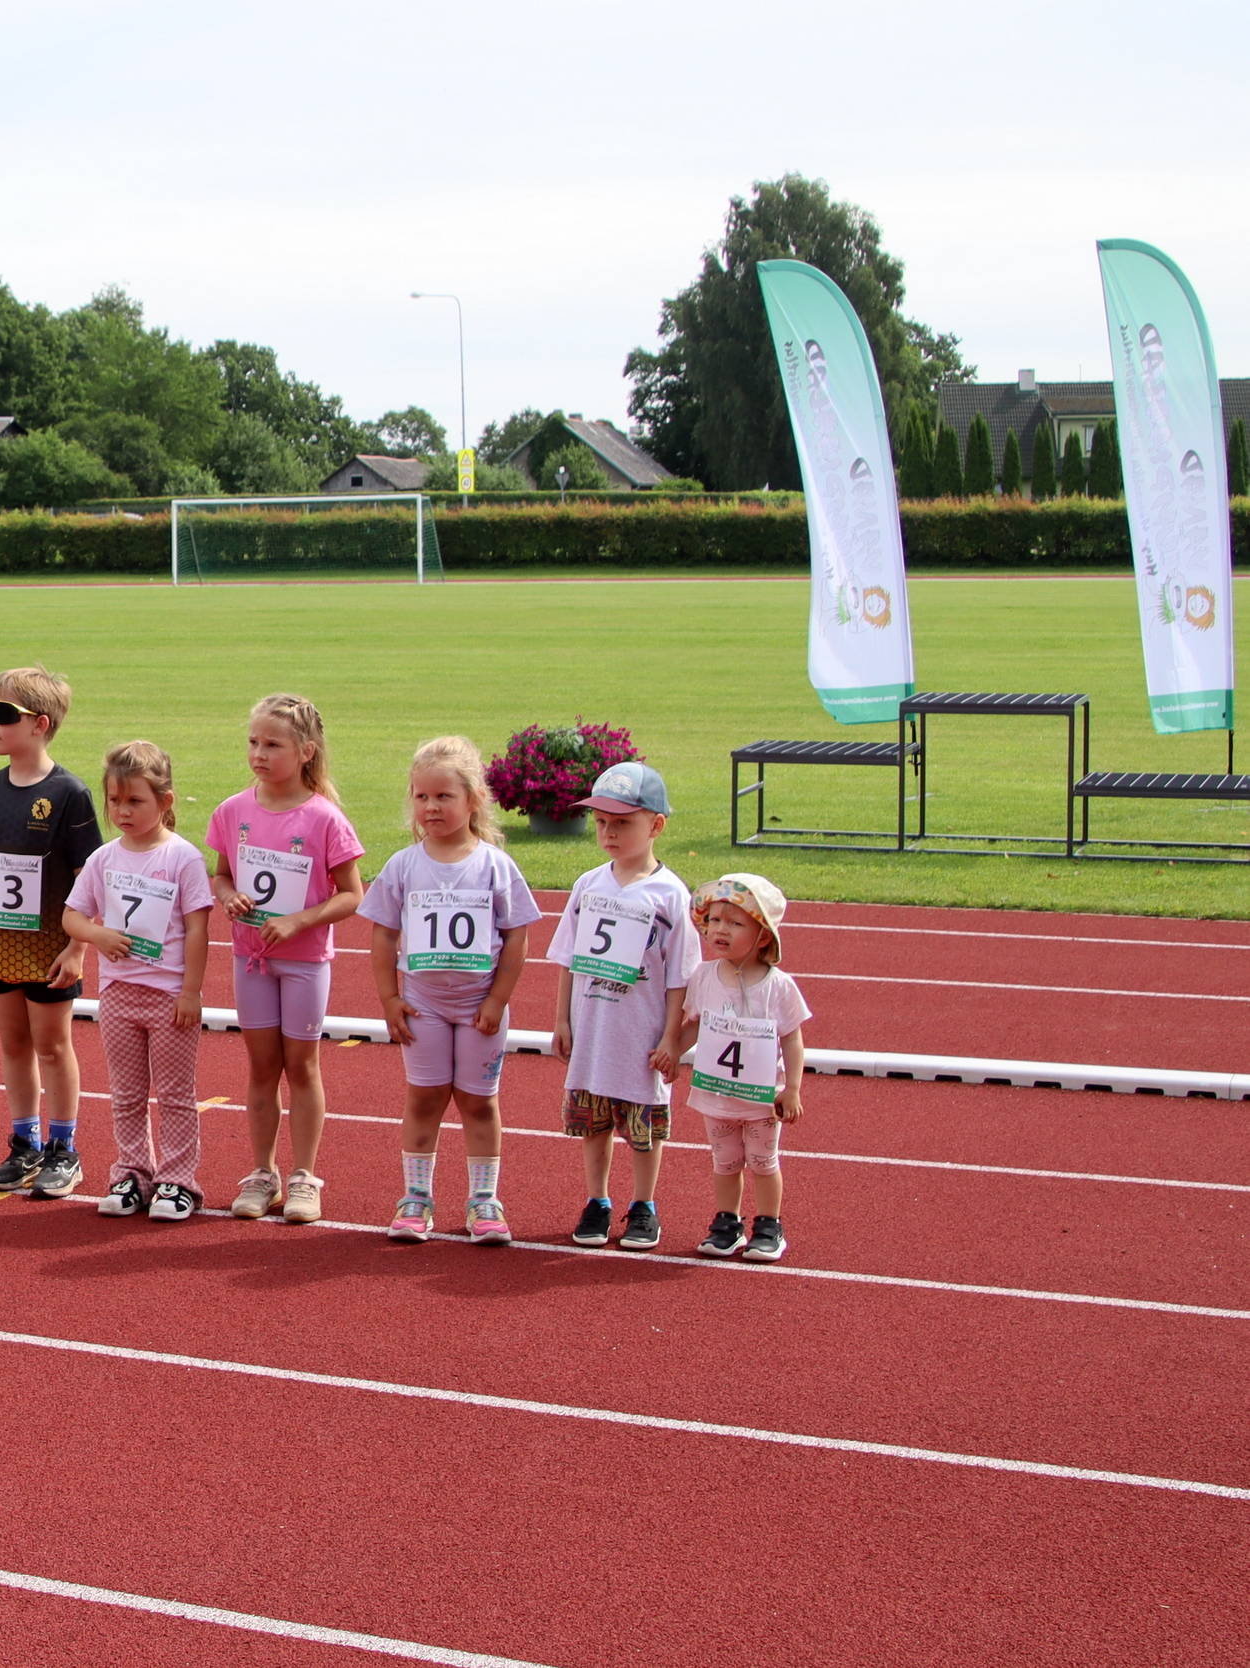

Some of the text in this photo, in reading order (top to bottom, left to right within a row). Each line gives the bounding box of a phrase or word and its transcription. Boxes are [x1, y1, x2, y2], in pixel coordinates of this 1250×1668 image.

[253, 870, 277, 906] 9
[121, 894, 143, 929] 7
[423, 911, 476, 950] 10
[589, 917, 617, 955] 5
[589, 977, 629, 996] Pasta
[717, 1040, 745, 1079] 4
